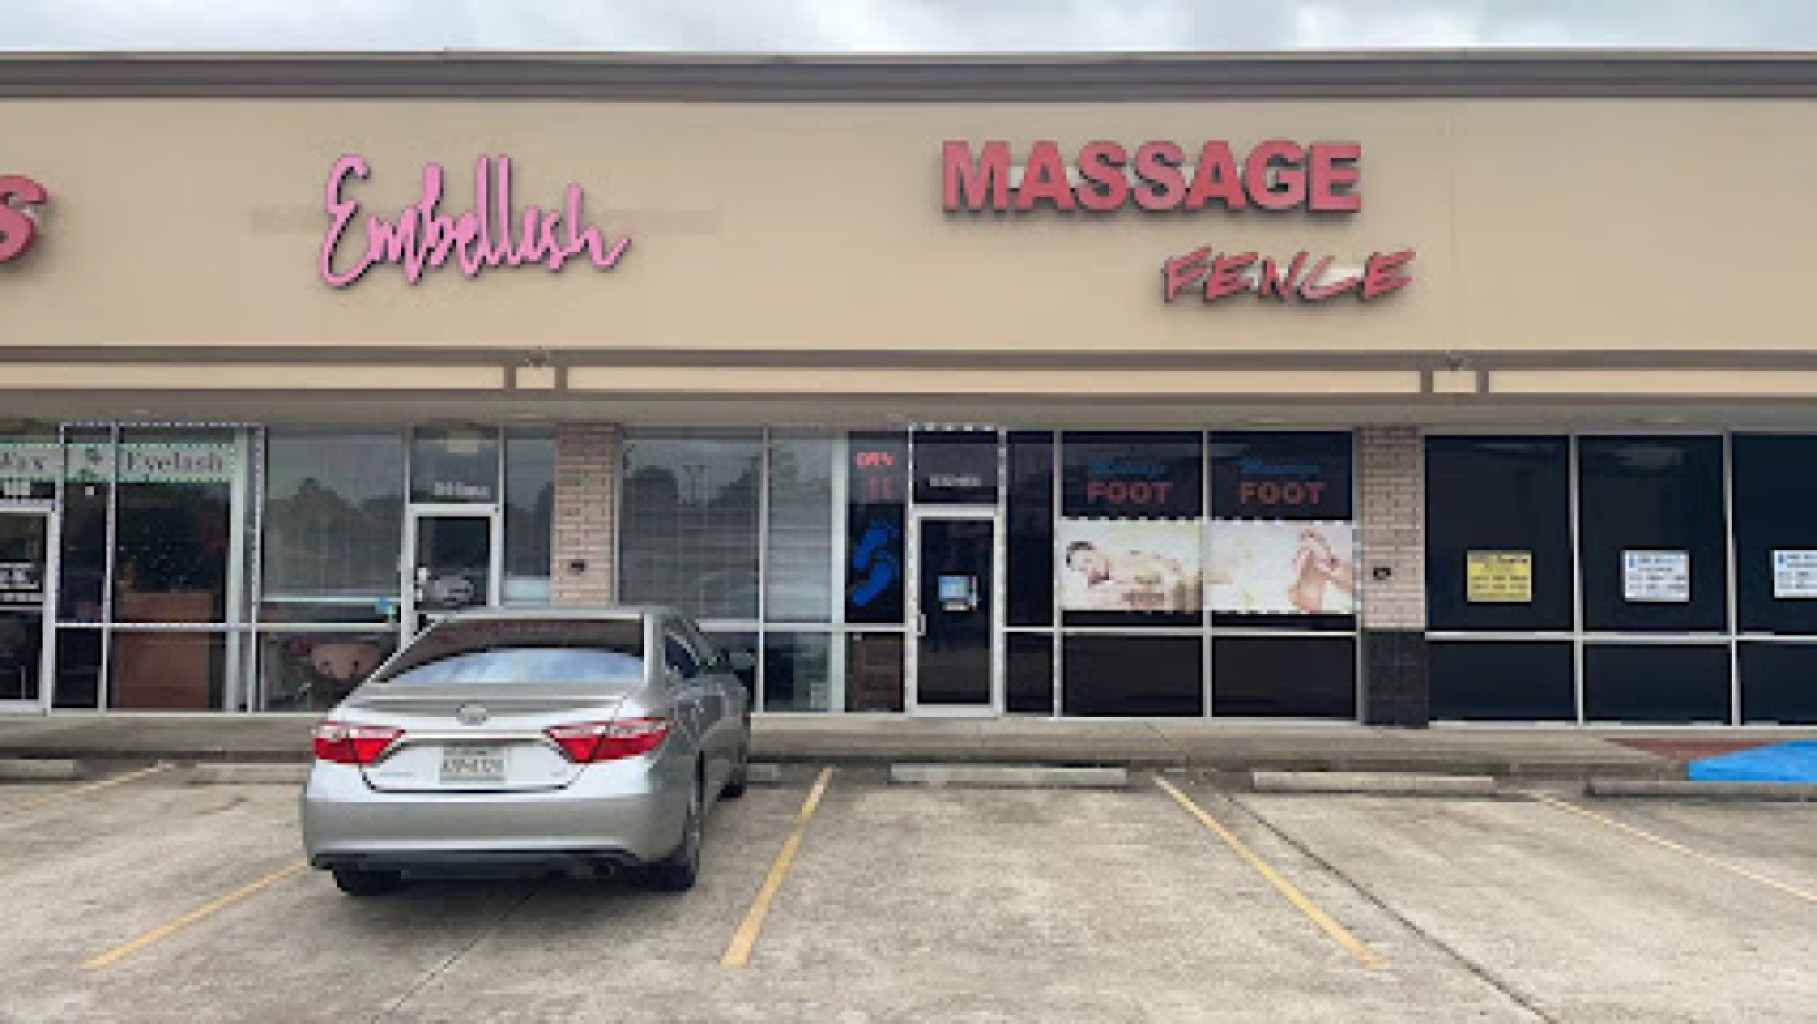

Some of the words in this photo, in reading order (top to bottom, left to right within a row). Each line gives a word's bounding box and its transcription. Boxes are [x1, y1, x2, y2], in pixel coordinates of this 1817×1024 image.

[942, 140, 1362, 212] MASSAGE
[319, 154, 631, 287] Embellish
[1162, 247, 1416, 302] FENCE
[124, 451, 223, 475] Eyelash
[1088, 481, 1173, 504] FOOT
[1240, 481, 1327, 504] FOOT
